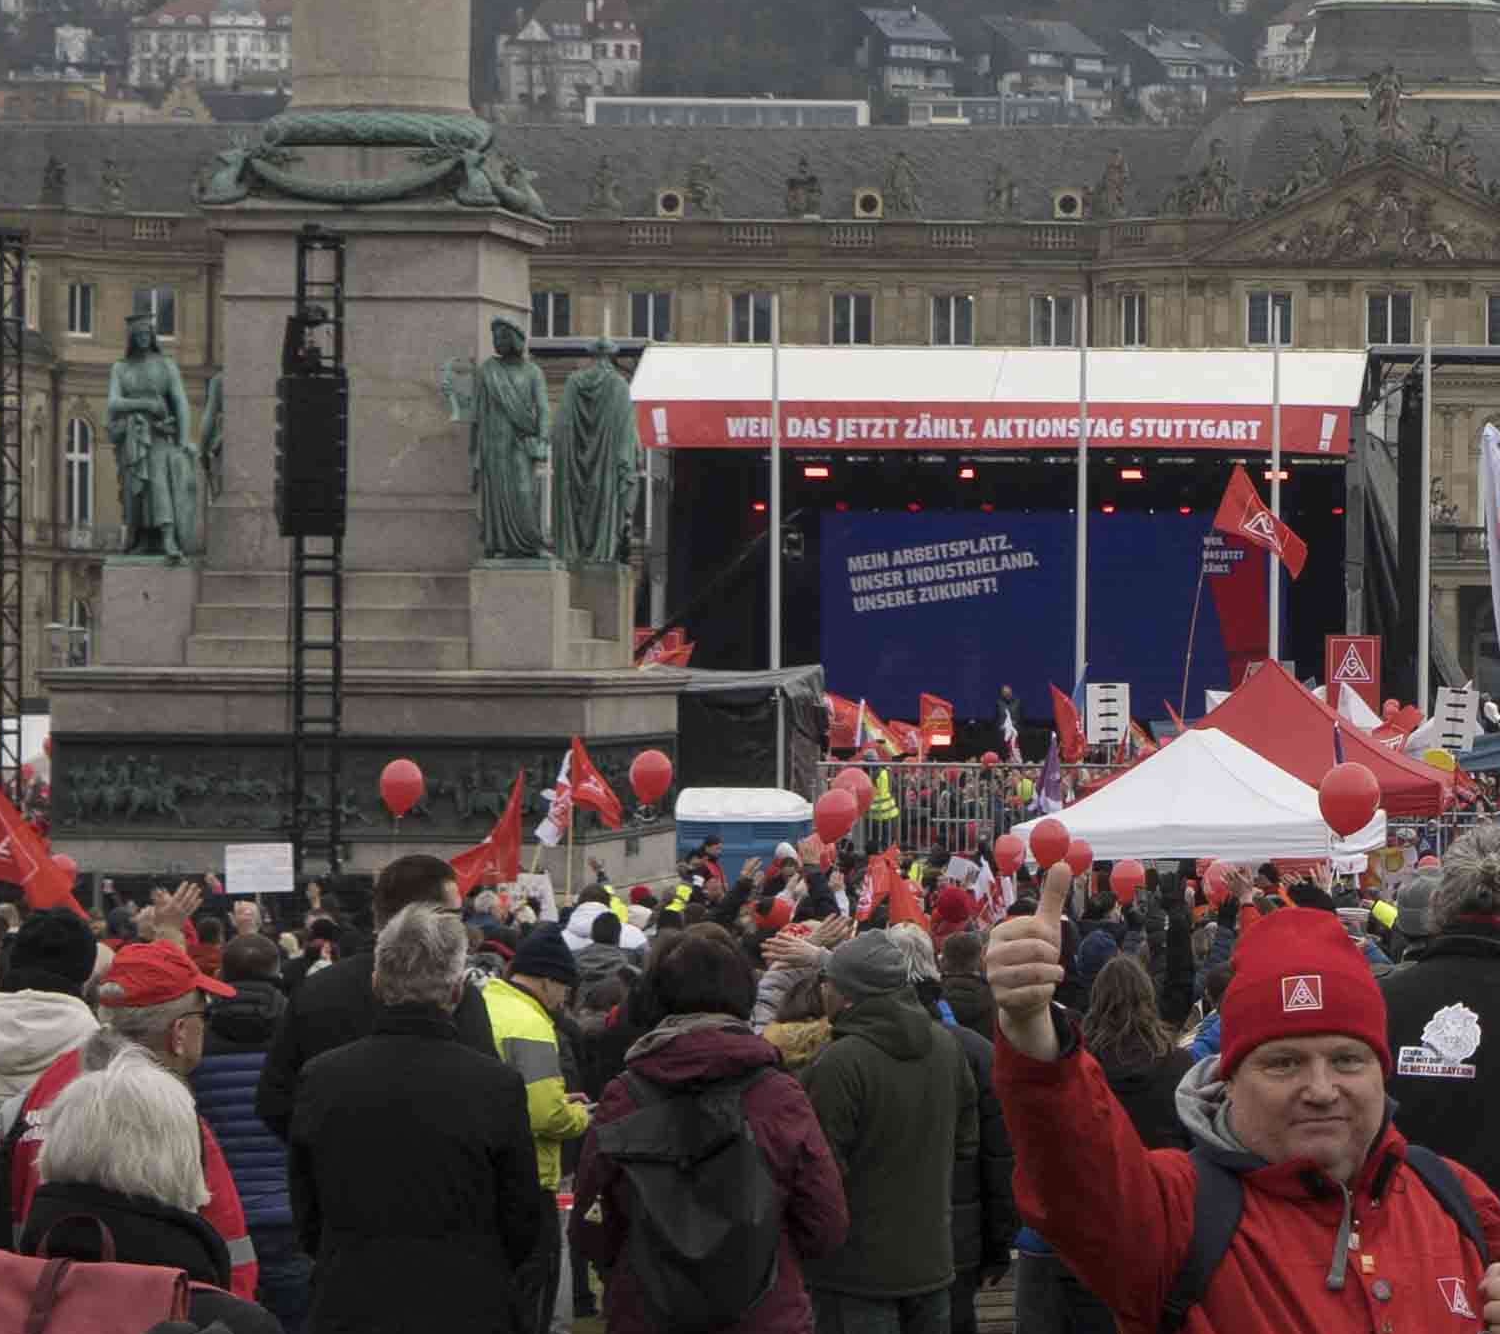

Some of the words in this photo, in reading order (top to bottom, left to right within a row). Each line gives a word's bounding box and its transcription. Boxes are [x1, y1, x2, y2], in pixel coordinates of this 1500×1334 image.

[787, 417, 831, 439] DAS
[836, 418, 899, 443] JETZT
[904, 413, 976, 439] ZÄHLT.
[982, 418, 1124, 440] AKTIONSTAG
[1129, 418, 1262, 441] STUTTGART
[847, 552, 889, 572] MEIN
[892, 534, 1013, 566] ARBEITSPLATZ.
[850, 569, 904, 592] UNSER
[907, 551, 1040, 584] INDUSTRIELAND.
[852, 588, 916, 612] UNSERE
[918, 577, 998, 603] ZUKUNFT!
